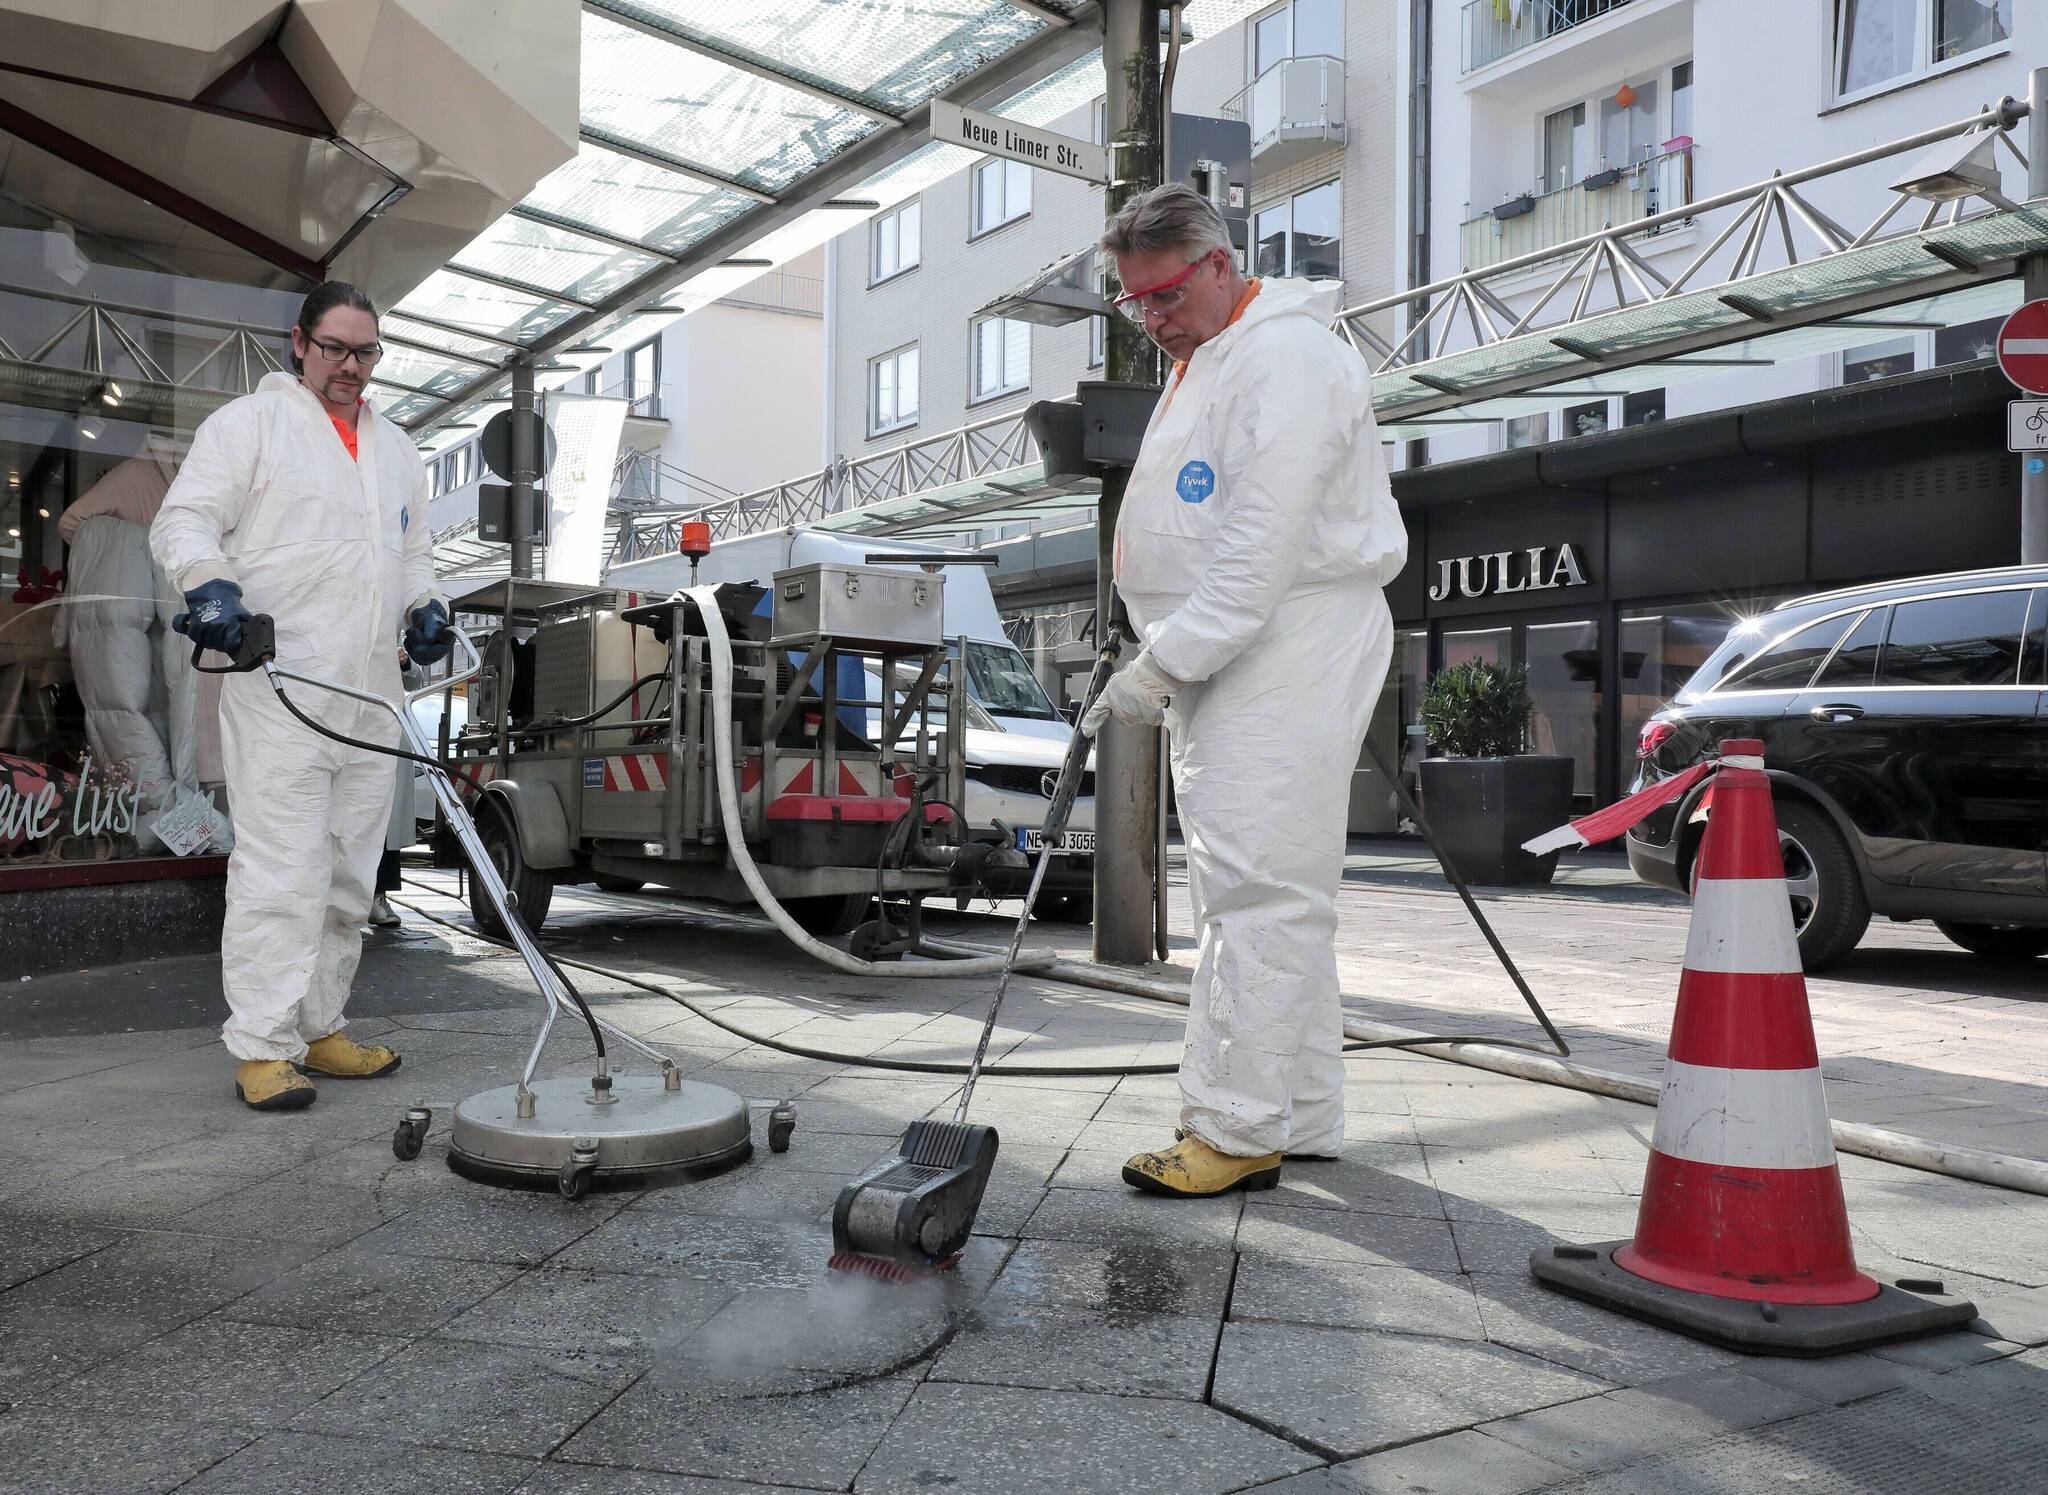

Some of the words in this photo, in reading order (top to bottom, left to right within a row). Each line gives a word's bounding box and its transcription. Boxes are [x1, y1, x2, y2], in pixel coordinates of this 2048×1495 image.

[962, 117, 998, 146] Neue
[1005, 129, 1049, 160] Linner
[1056, 144, 1083, 170] Str.
[1183, 475, 1208, 487] Tyvek
[1428, 543, 1587, 601] JULIA
[1026, 831, 1042, 848] NE
